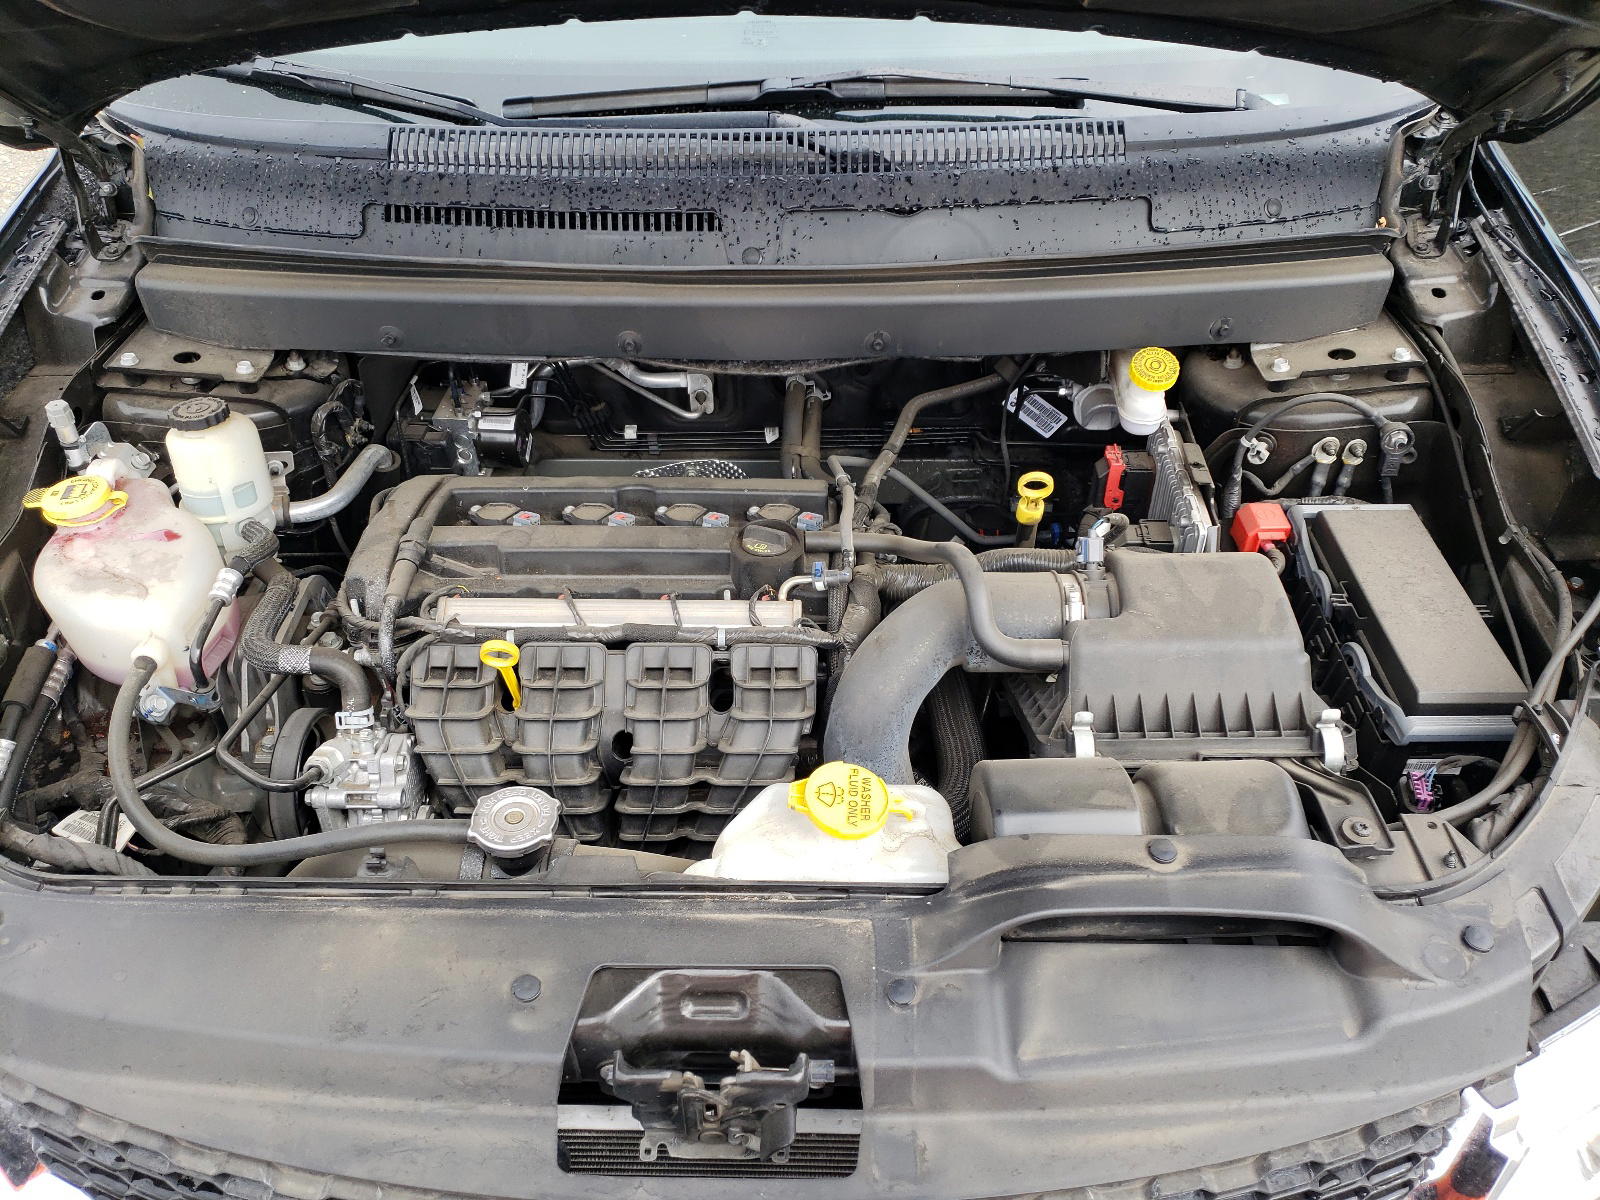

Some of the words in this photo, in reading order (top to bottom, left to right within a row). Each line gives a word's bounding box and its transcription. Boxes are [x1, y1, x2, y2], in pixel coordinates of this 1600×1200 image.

[848, 768, 859, 797] FLUID
[480, 797, 497, 814] HOT
[860, 777, 872, 821] WASHER
[847, 800, 859, 827] ONLY
[480, 827, 503, 842] TIGHT
[511, 828, 541, 842] KEEP
